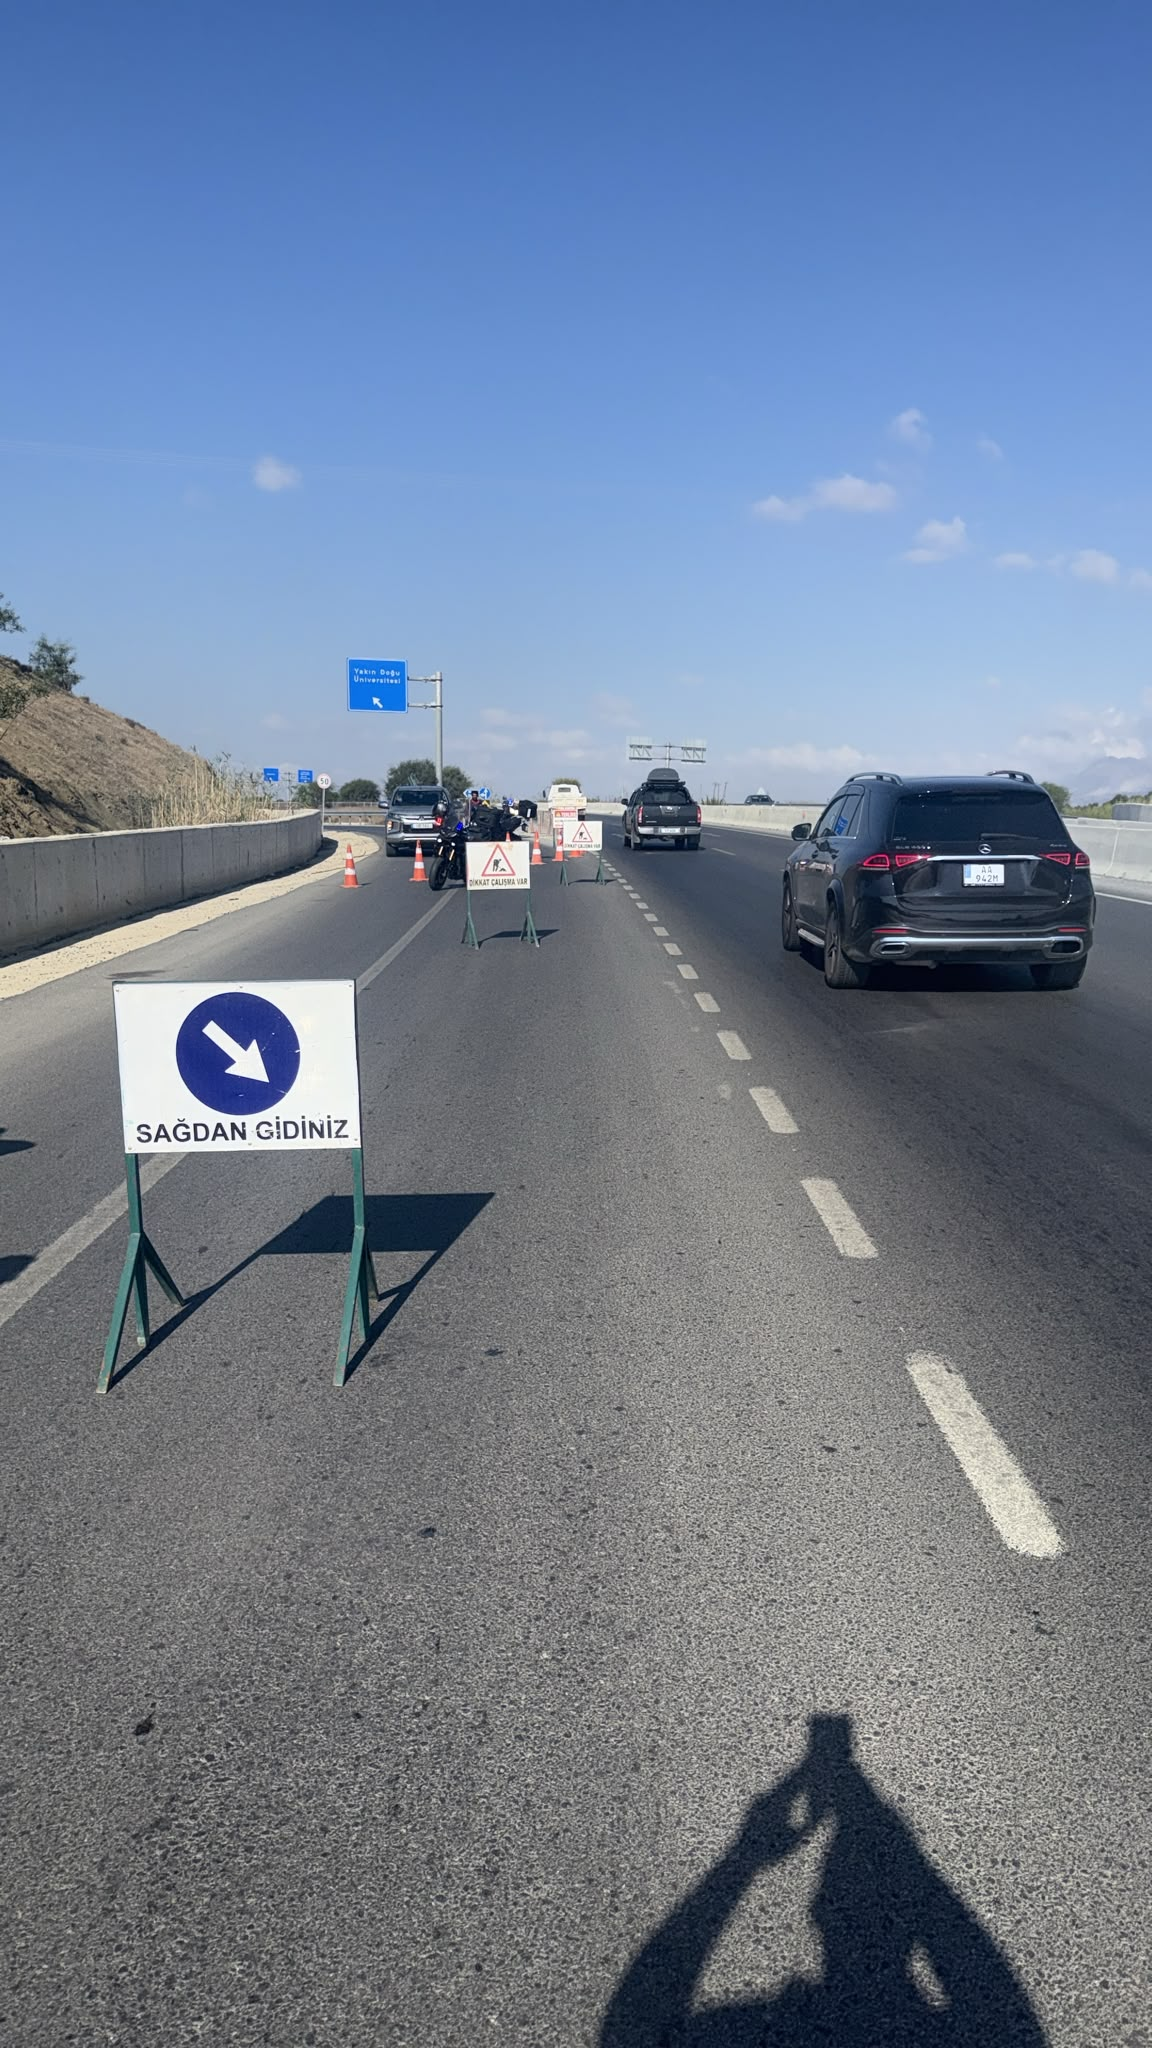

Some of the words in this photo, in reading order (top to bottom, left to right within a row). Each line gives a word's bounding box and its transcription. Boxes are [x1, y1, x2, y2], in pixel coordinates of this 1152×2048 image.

[380, 669, 400, 677] Doğu
[353, 674, 401, 684] Üniversitesi
[320, 777, 329, 785] 50
[981, 865, 992, 873] AA
[976, 874, 999, 882] 942M
[491, 878, 516, 887] ÇALIŞMA
[136, 1117, 247, 1143] SAĞDAN
[256, 1115, 349, 1140] GİDİNİZ
